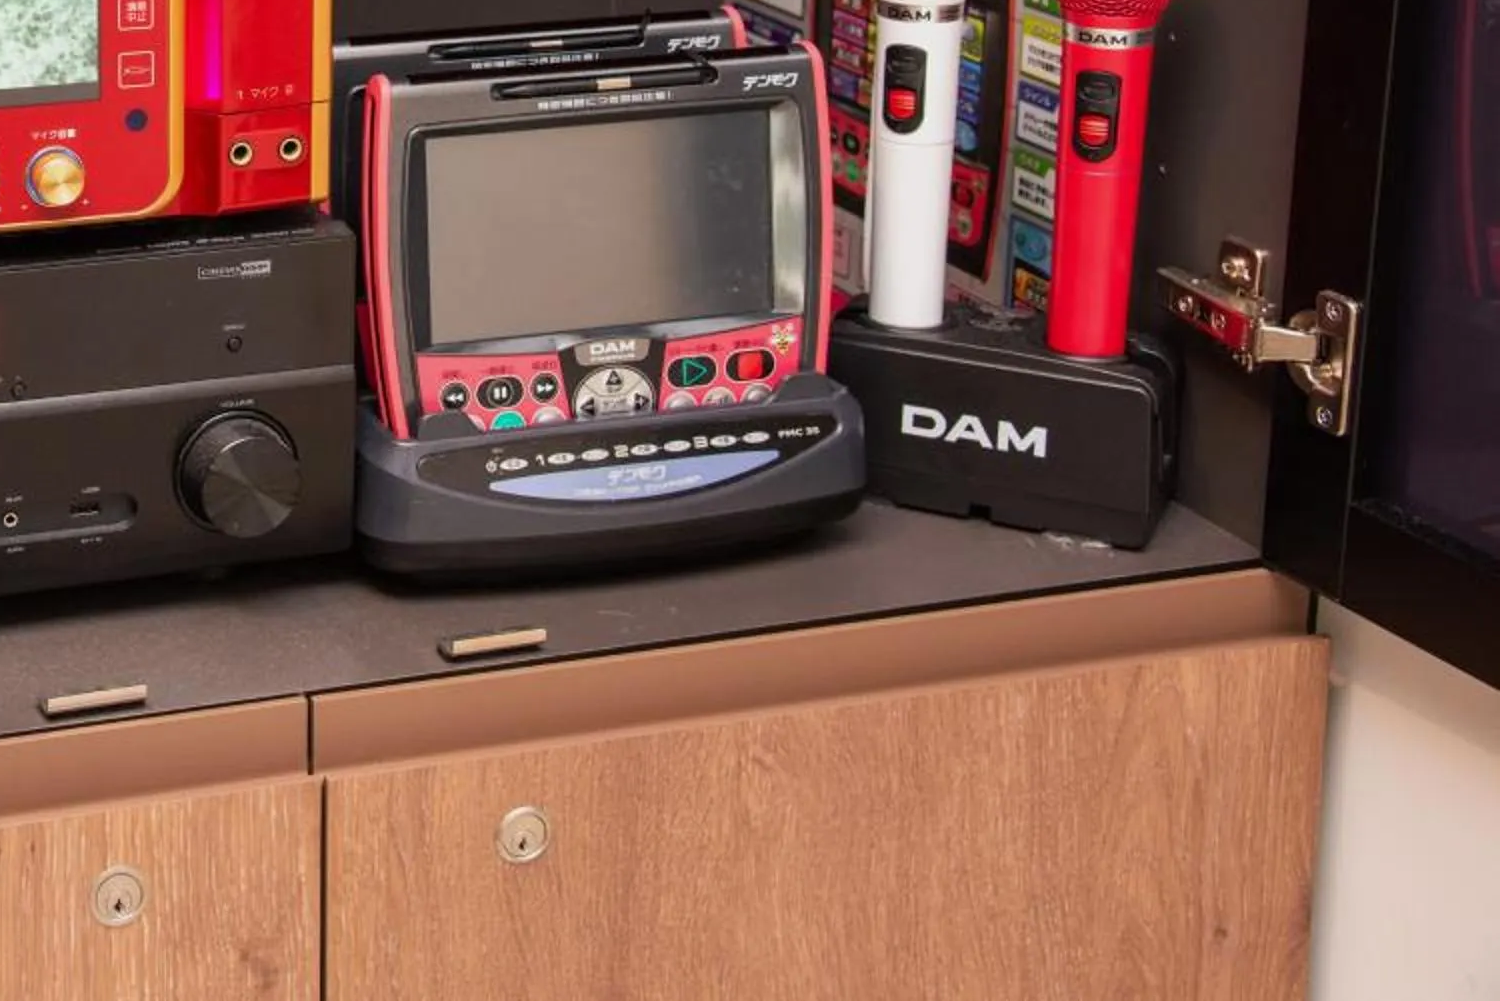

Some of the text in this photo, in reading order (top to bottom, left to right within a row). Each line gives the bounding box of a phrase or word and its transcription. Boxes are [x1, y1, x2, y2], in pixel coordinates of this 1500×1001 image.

[887, 6, 931, 21] DAM
[1079, 31, 1127, 45] DAM
[589, 339, 636, 355] DAM
[901, 403, 1048, 458] DAM
